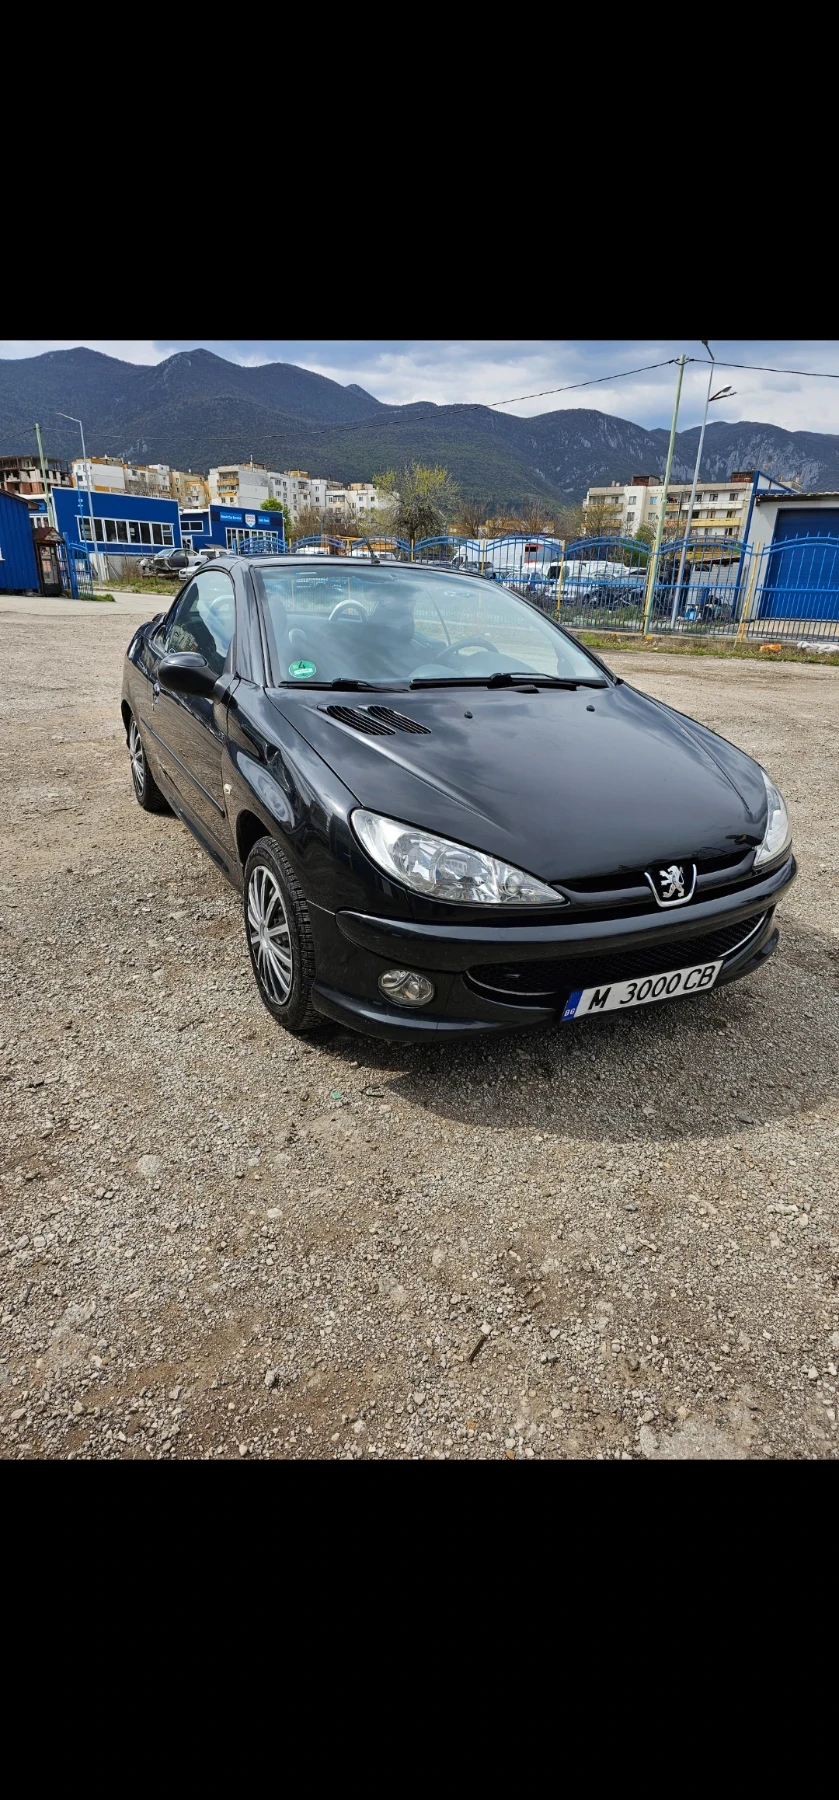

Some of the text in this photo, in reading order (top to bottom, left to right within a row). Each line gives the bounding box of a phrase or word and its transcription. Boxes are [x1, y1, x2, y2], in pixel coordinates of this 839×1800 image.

[298, 661, 306, 669] 4
[588, 987, 612, 1011] M
[564, 1008, 576, 1017] BG
